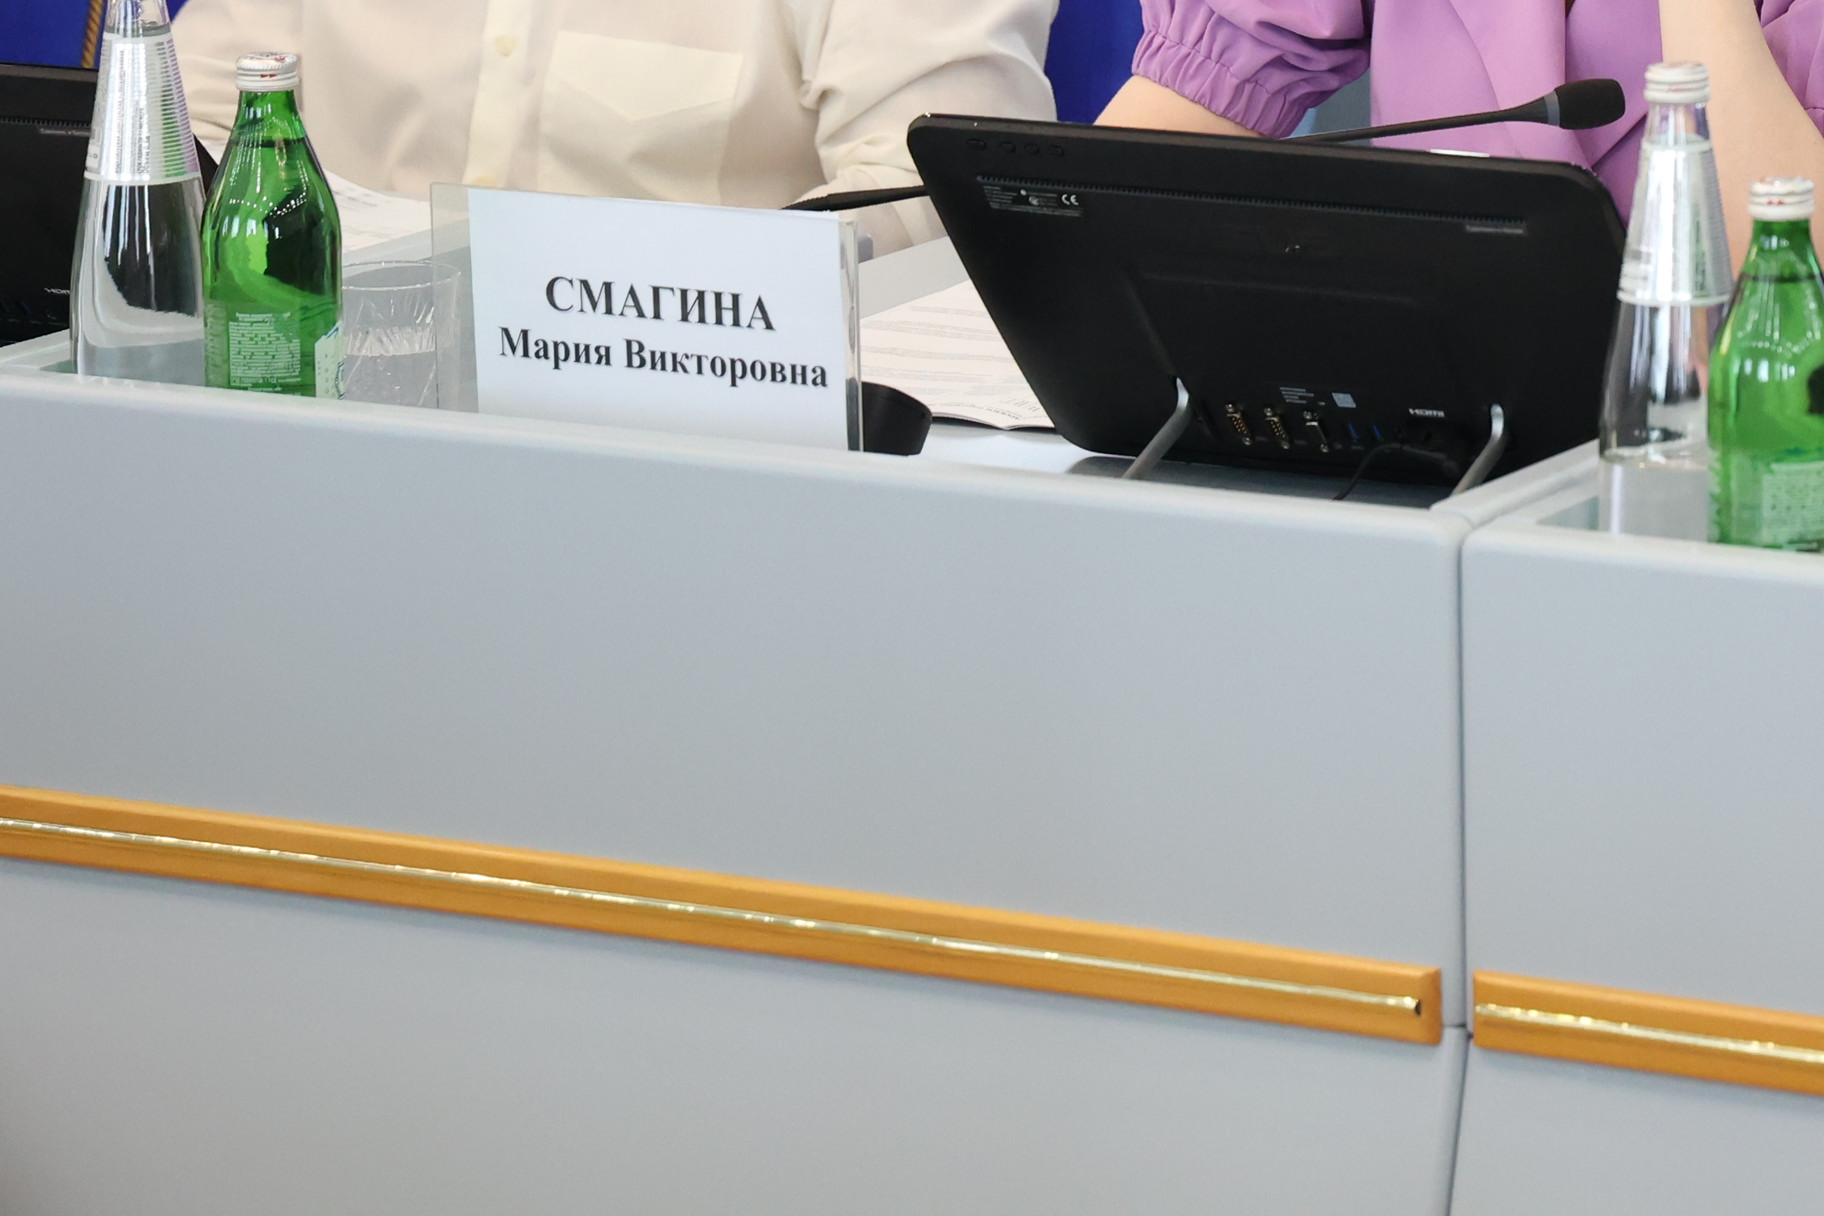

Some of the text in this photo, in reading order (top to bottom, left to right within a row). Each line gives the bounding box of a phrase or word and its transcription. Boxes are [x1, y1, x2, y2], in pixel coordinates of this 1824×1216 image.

[545, 275, 776, 331] СМАГИНА
[498, 325, 613, 370] Мария
[623, 337, 828, 388] Викторовна
